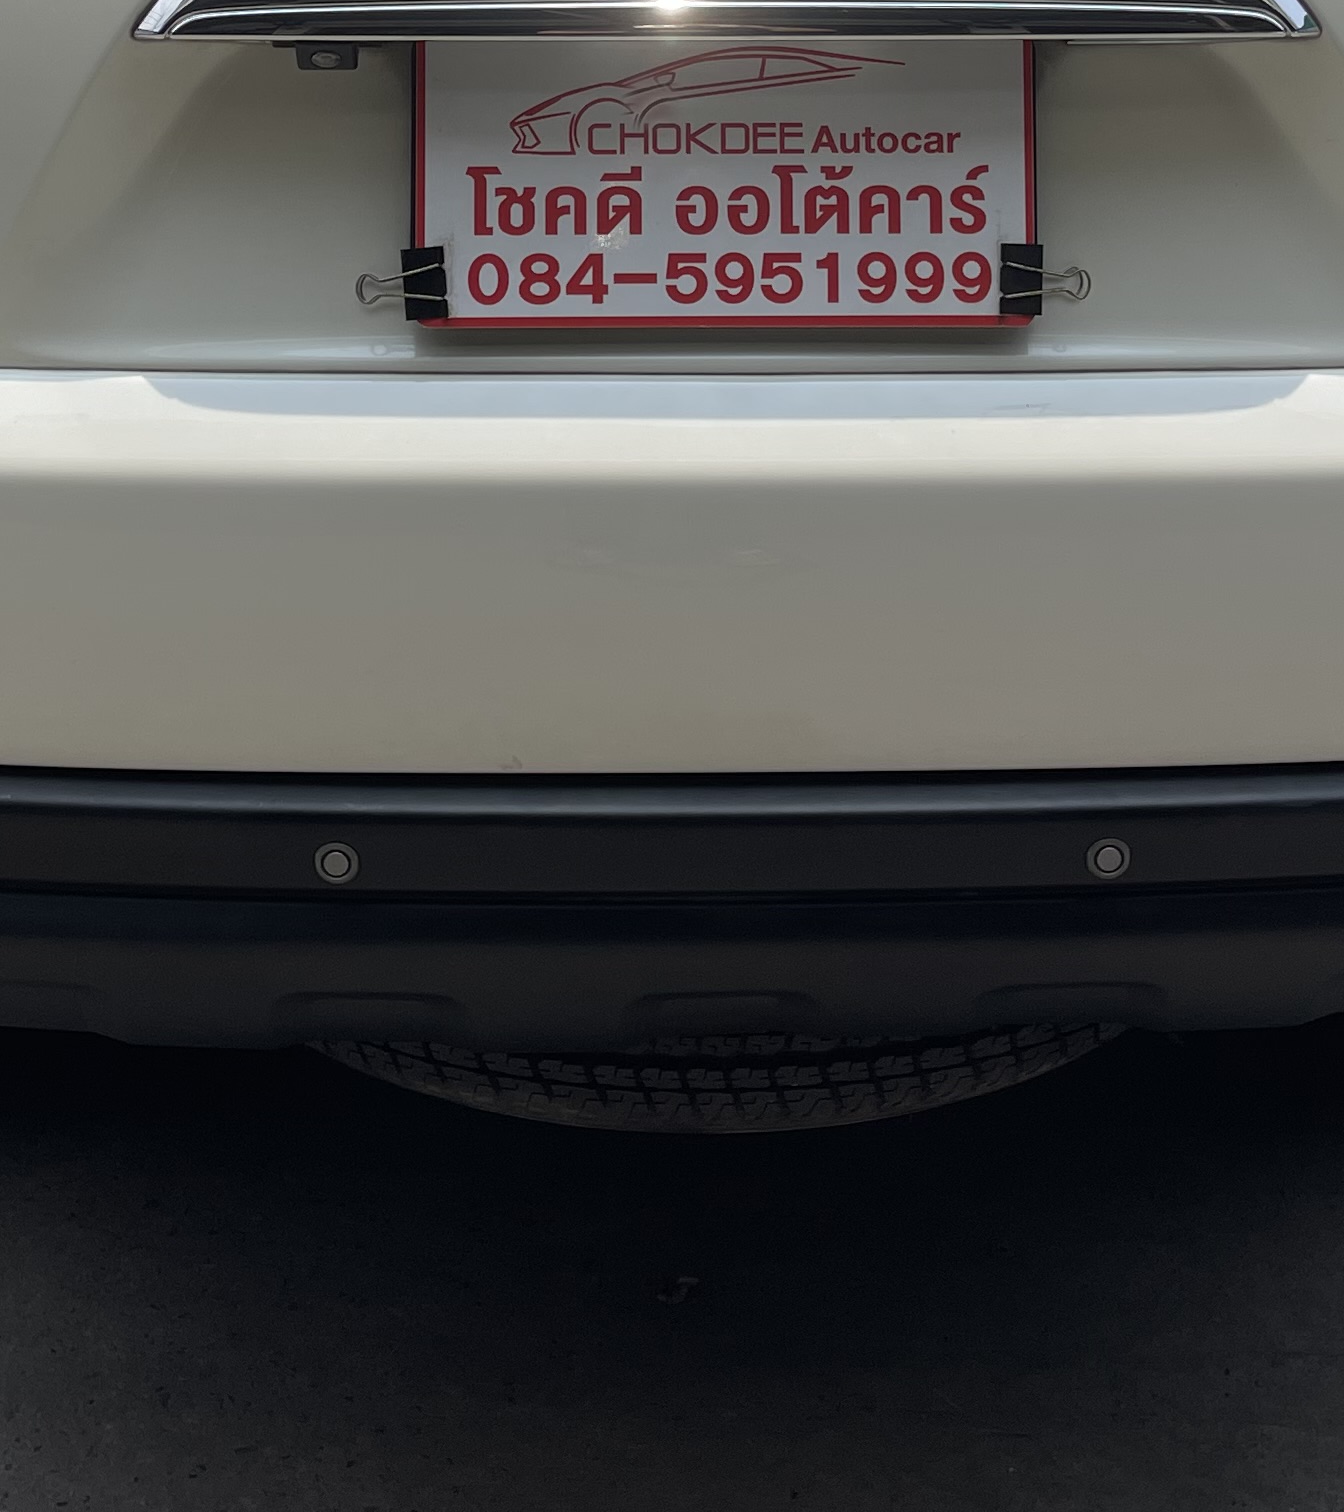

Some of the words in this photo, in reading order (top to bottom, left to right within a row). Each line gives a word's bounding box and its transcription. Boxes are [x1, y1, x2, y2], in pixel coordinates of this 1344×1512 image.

[587, 122, 805, 155] CHOKDEE
[810, 125, 962, 154] Autocar
[465, 165, 643, 236] โชคดี
[675, 164, 989, 235] ออโต้คาร์
[467, 251, 992, 305] 084-5951999
